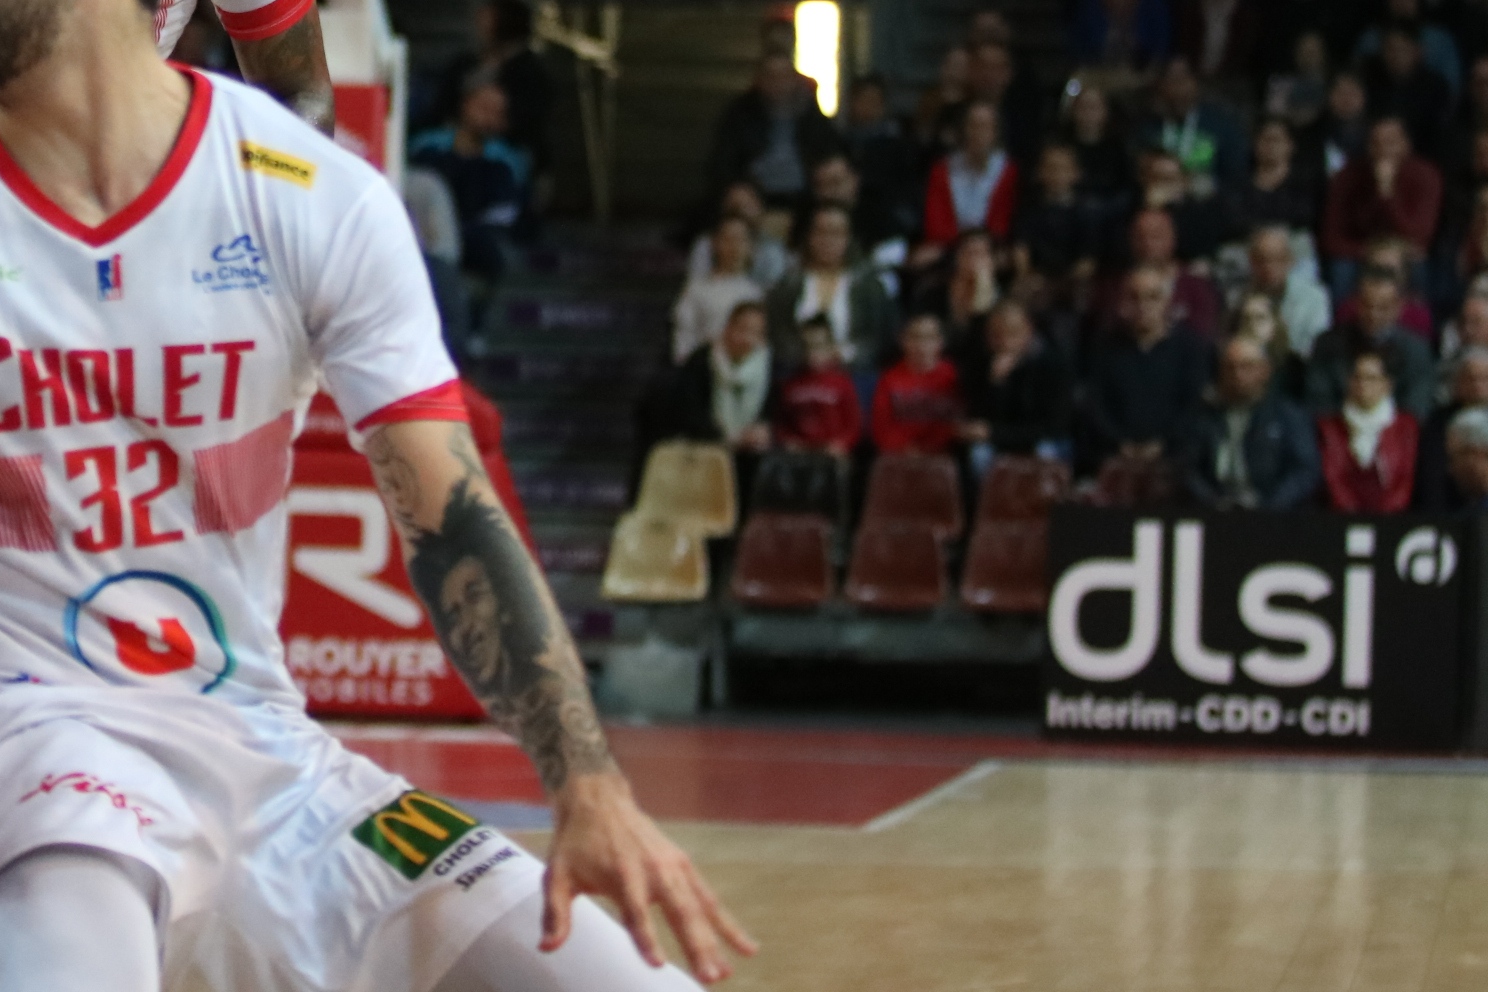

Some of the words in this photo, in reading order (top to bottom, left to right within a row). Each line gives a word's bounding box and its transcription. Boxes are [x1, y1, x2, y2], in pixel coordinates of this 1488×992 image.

[64, 439, 185, 555] 32
[286, 637, 446, 679] ROUYER
[1047, 517, 1378, 690] dlsi
